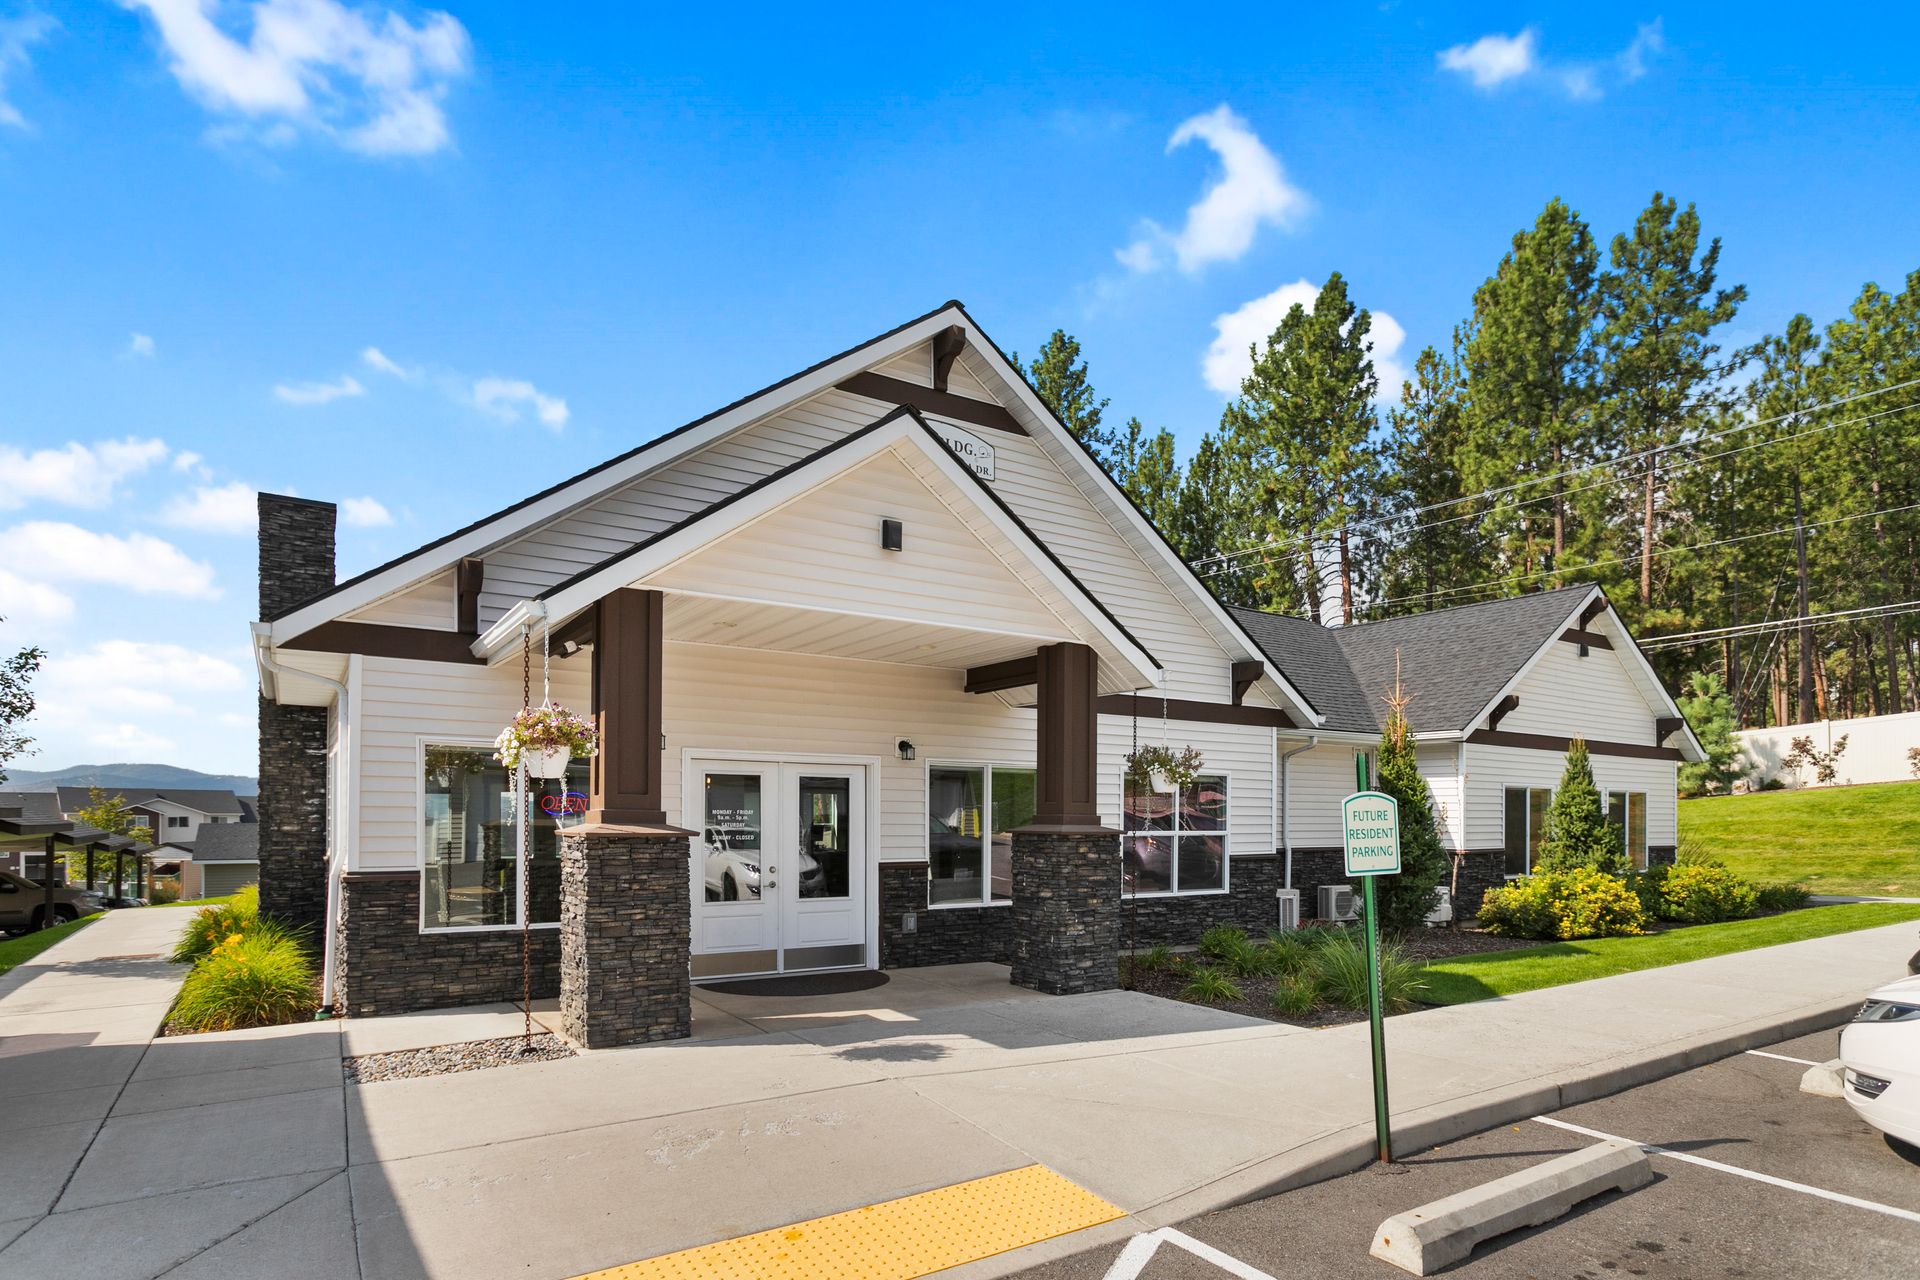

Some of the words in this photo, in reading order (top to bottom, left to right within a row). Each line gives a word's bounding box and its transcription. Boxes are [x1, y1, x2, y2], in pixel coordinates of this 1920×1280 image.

[976, 465, 992, 477] DR.
[541, 795, 588, 814] OPEN
[1353, 810, 1389, 822] FUTURE
[1349, 828, 1394, 840] RESIDENT
[1352, 845, 1393, 858] PARKING
